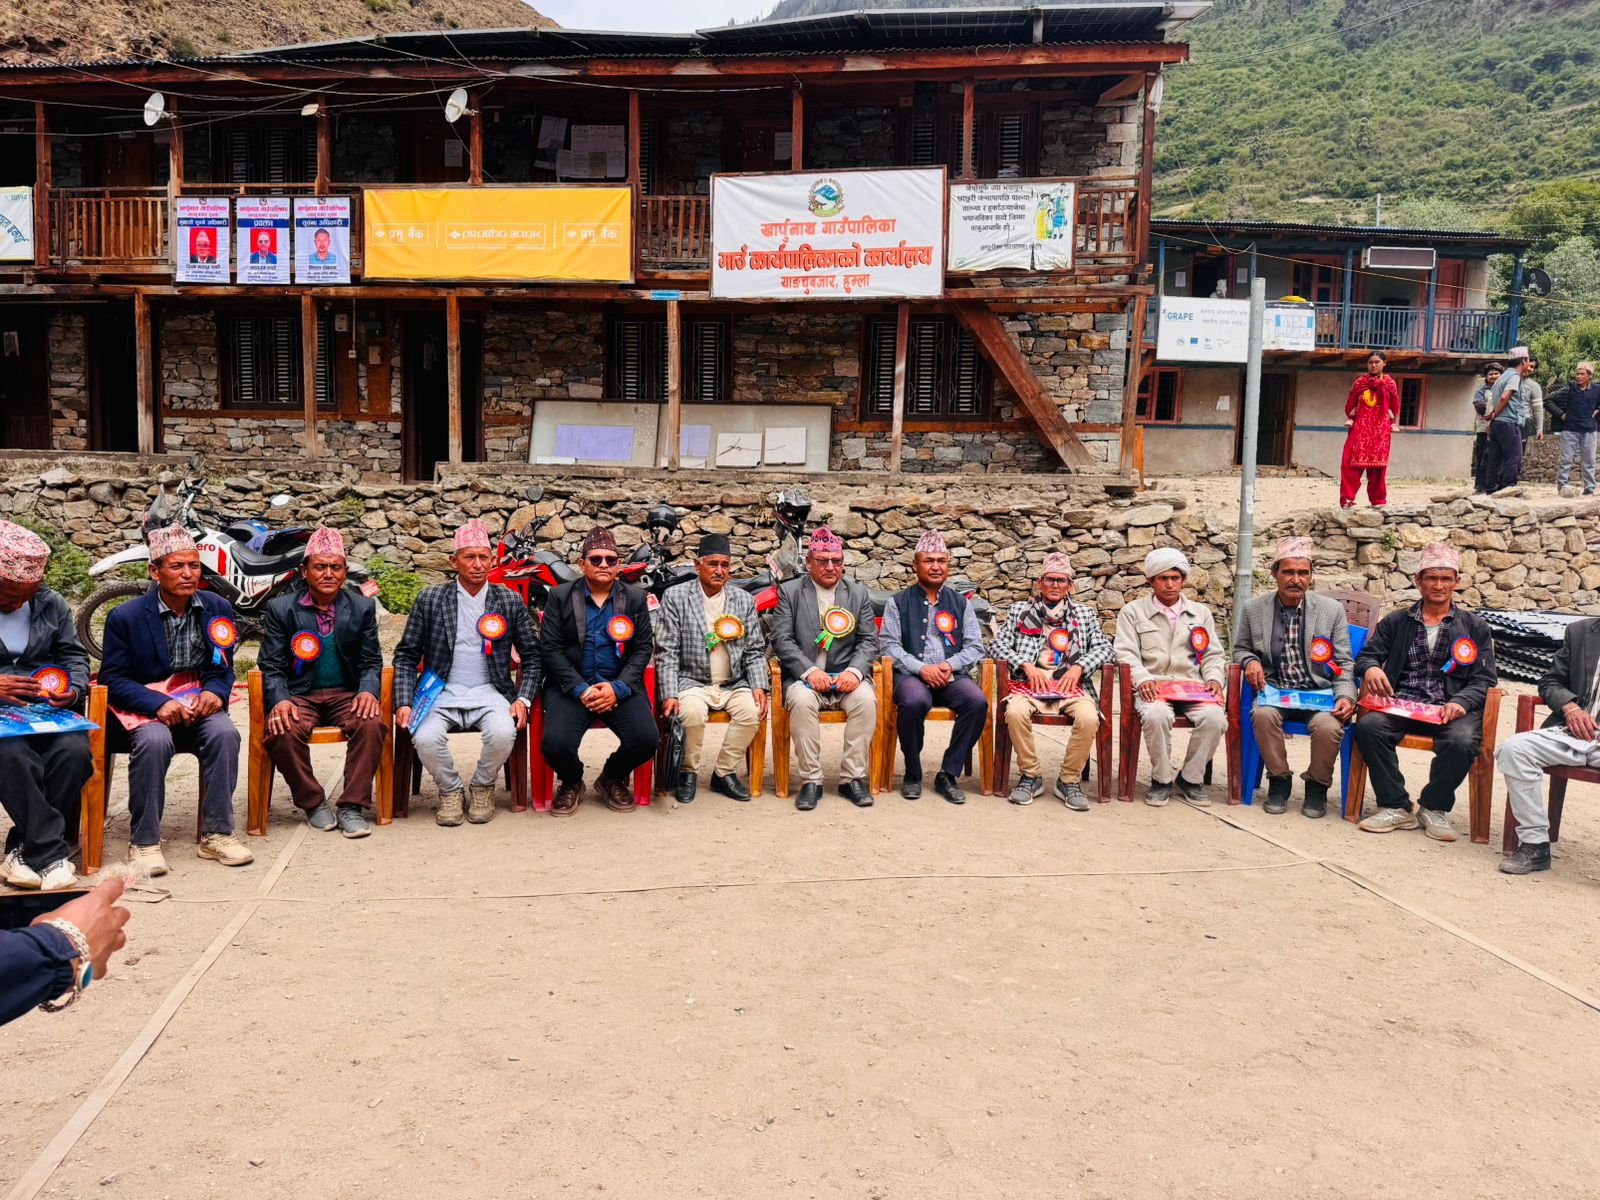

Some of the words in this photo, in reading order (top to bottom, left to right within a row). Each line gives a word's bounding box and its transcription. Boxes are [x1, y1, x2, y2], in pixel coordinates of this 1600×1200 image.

[760, 218, 817, 242] खार्पुनाथ
[821, 215, 897, 236] गाउँपालिका
[749, 241, 862, 272] कार्यपालिकाको
[864, 239, 934, 270] कार्यालय
[843, 273, 871, 294] हुम्ला
[1167, 312, 1194, 321] GRAPE
[196, 543, 216, 552] ero
